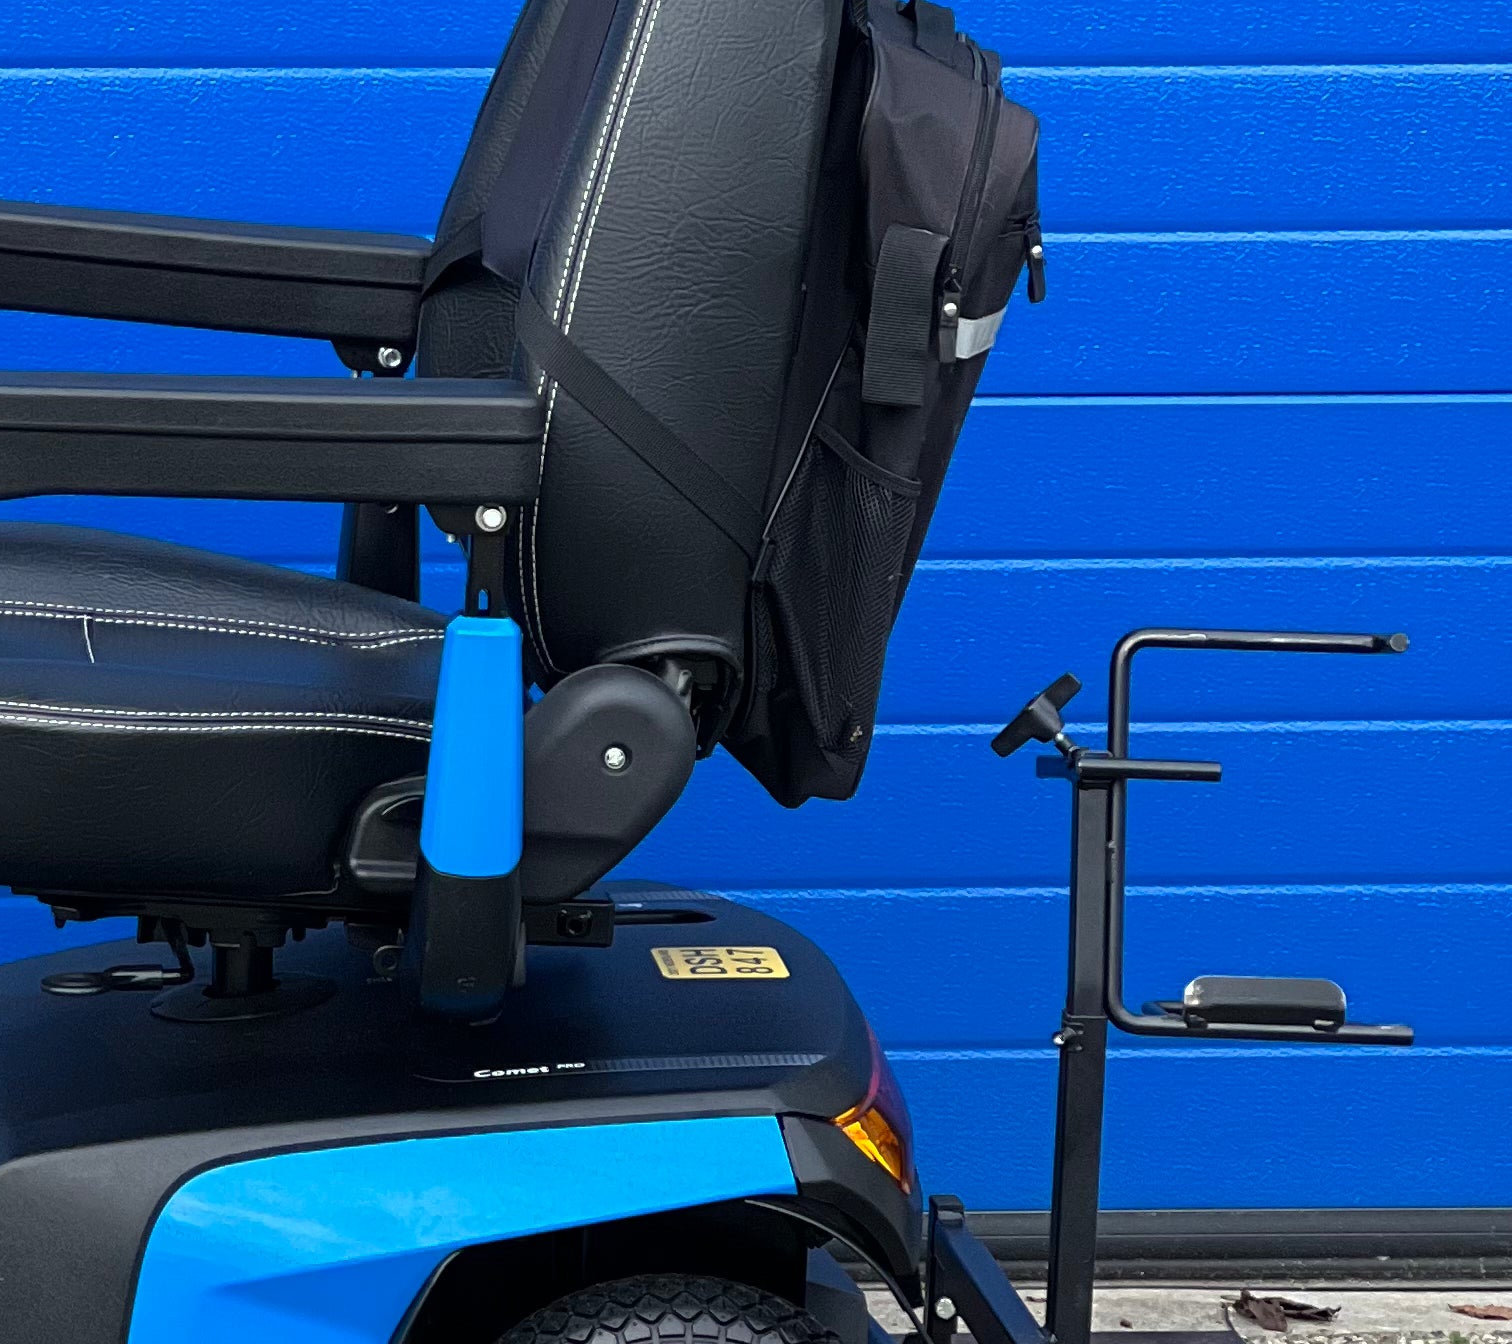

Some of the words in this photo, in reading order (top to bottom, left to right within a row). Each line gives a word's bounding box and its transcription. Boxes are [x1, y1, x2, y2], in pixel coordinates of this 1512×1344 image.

[680, 949, 728, 975] DSH
[726, 949, 774, 974] 847
[473, 1066, 549, 1077] Comet
